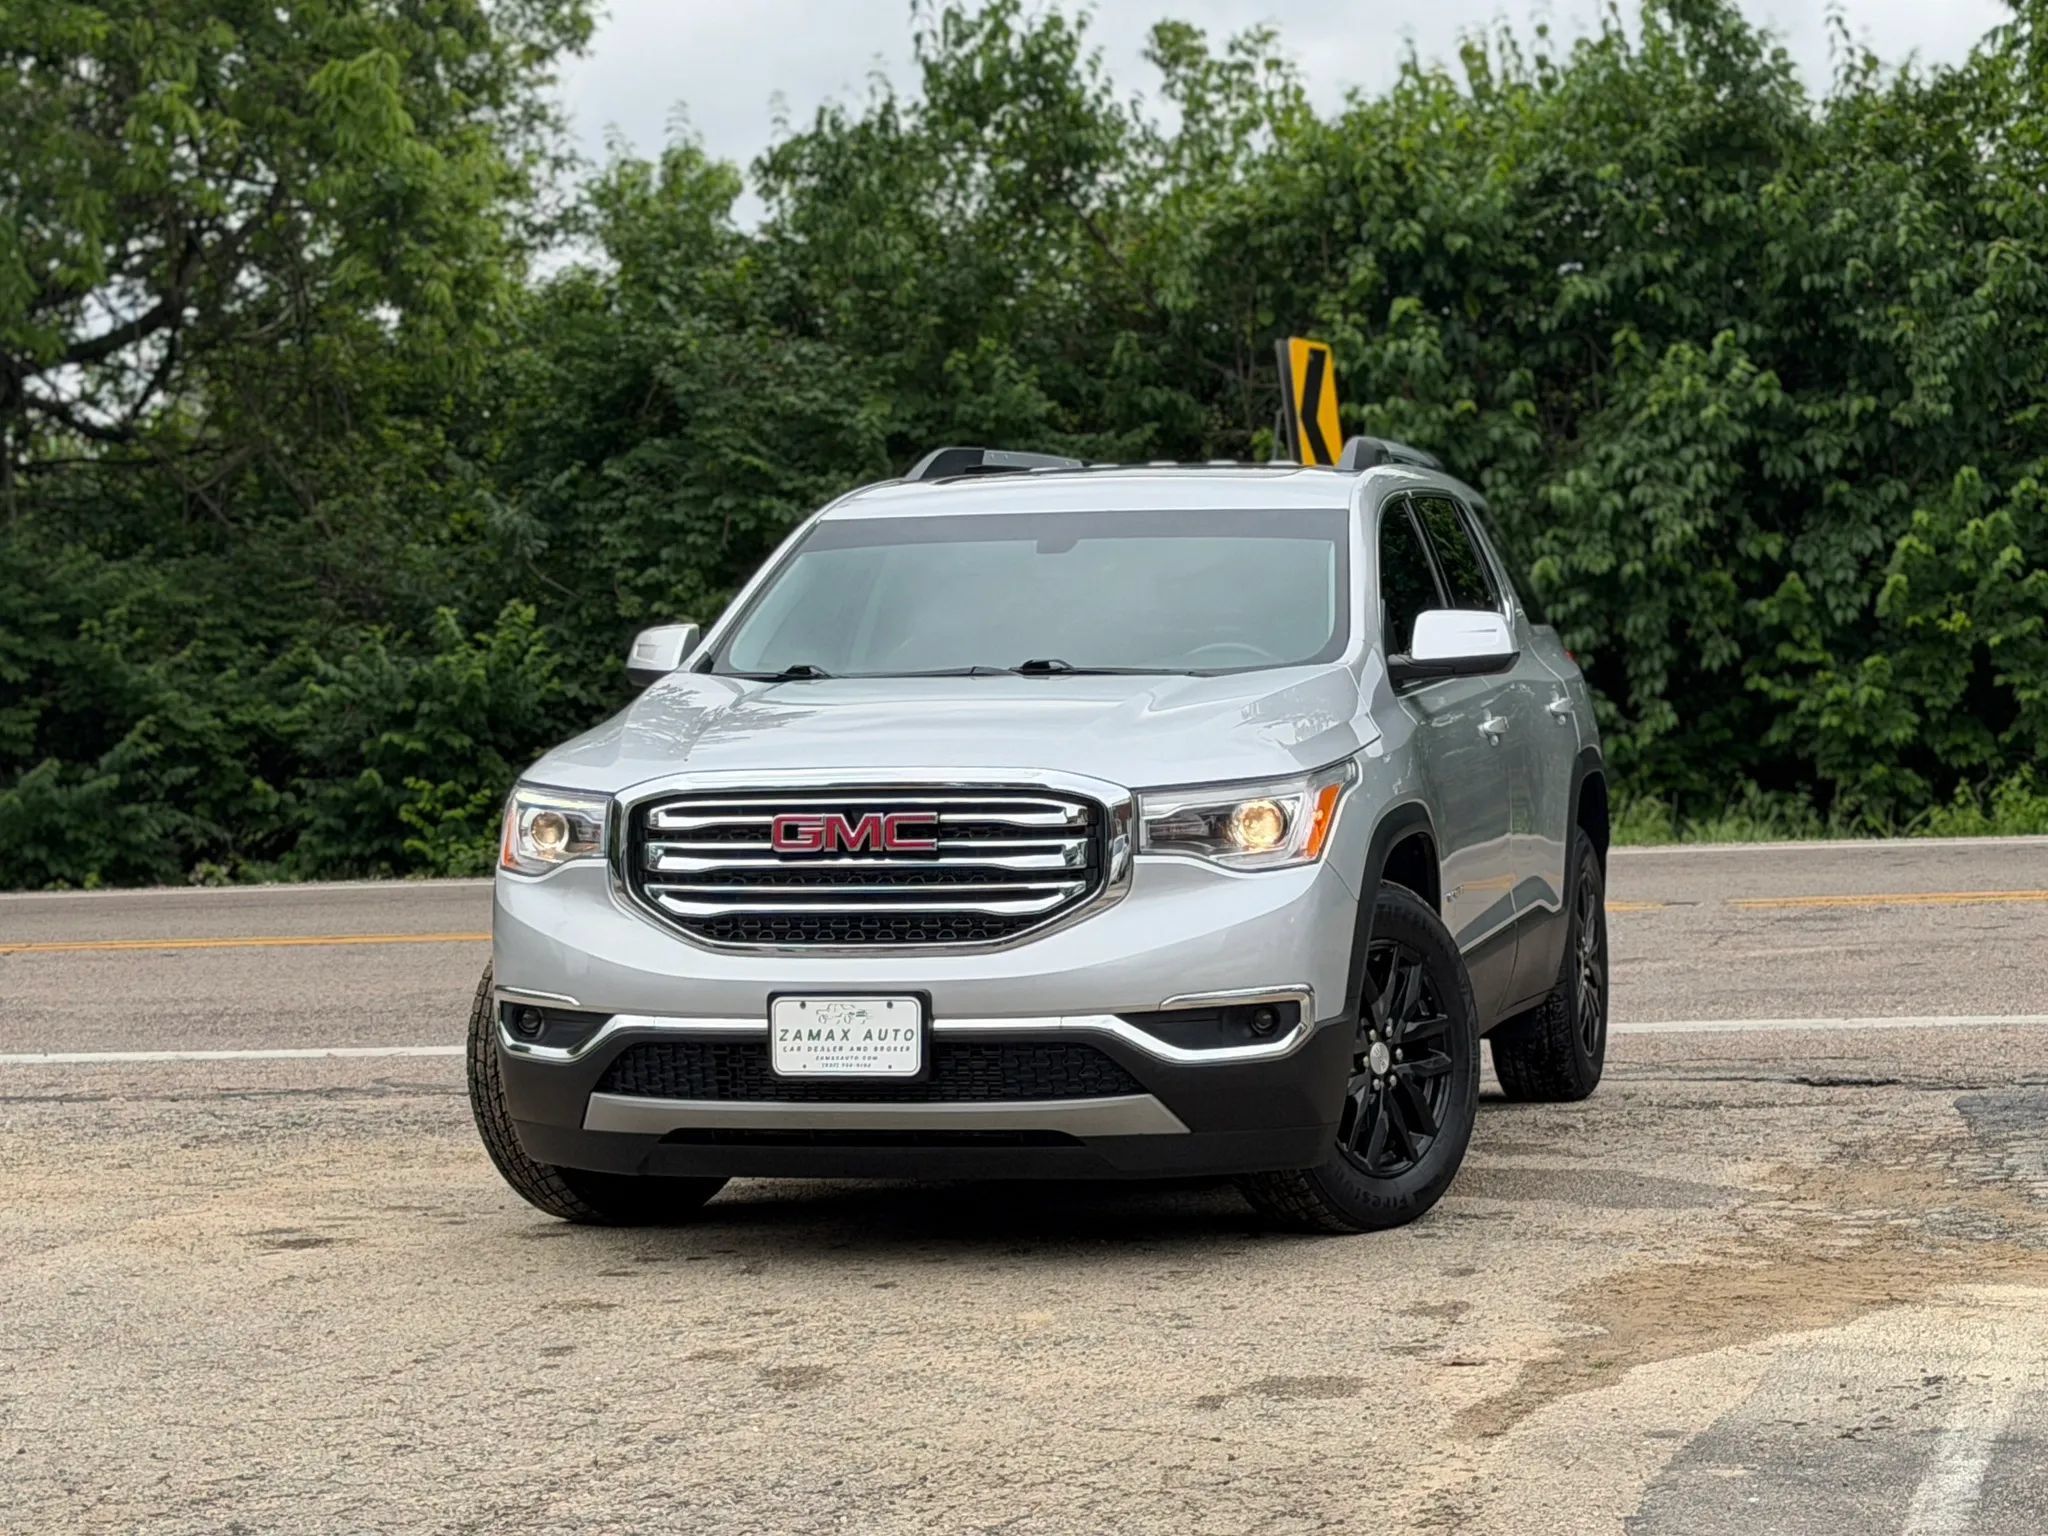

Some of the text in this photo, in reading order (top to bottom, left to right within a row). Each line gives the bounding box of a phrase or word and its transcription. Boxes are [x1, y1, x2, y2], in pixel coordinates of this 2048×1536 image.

[771, 812, 938, 852] GMC
[779, 1028, 915, 1042] ZAMAX AUTO
